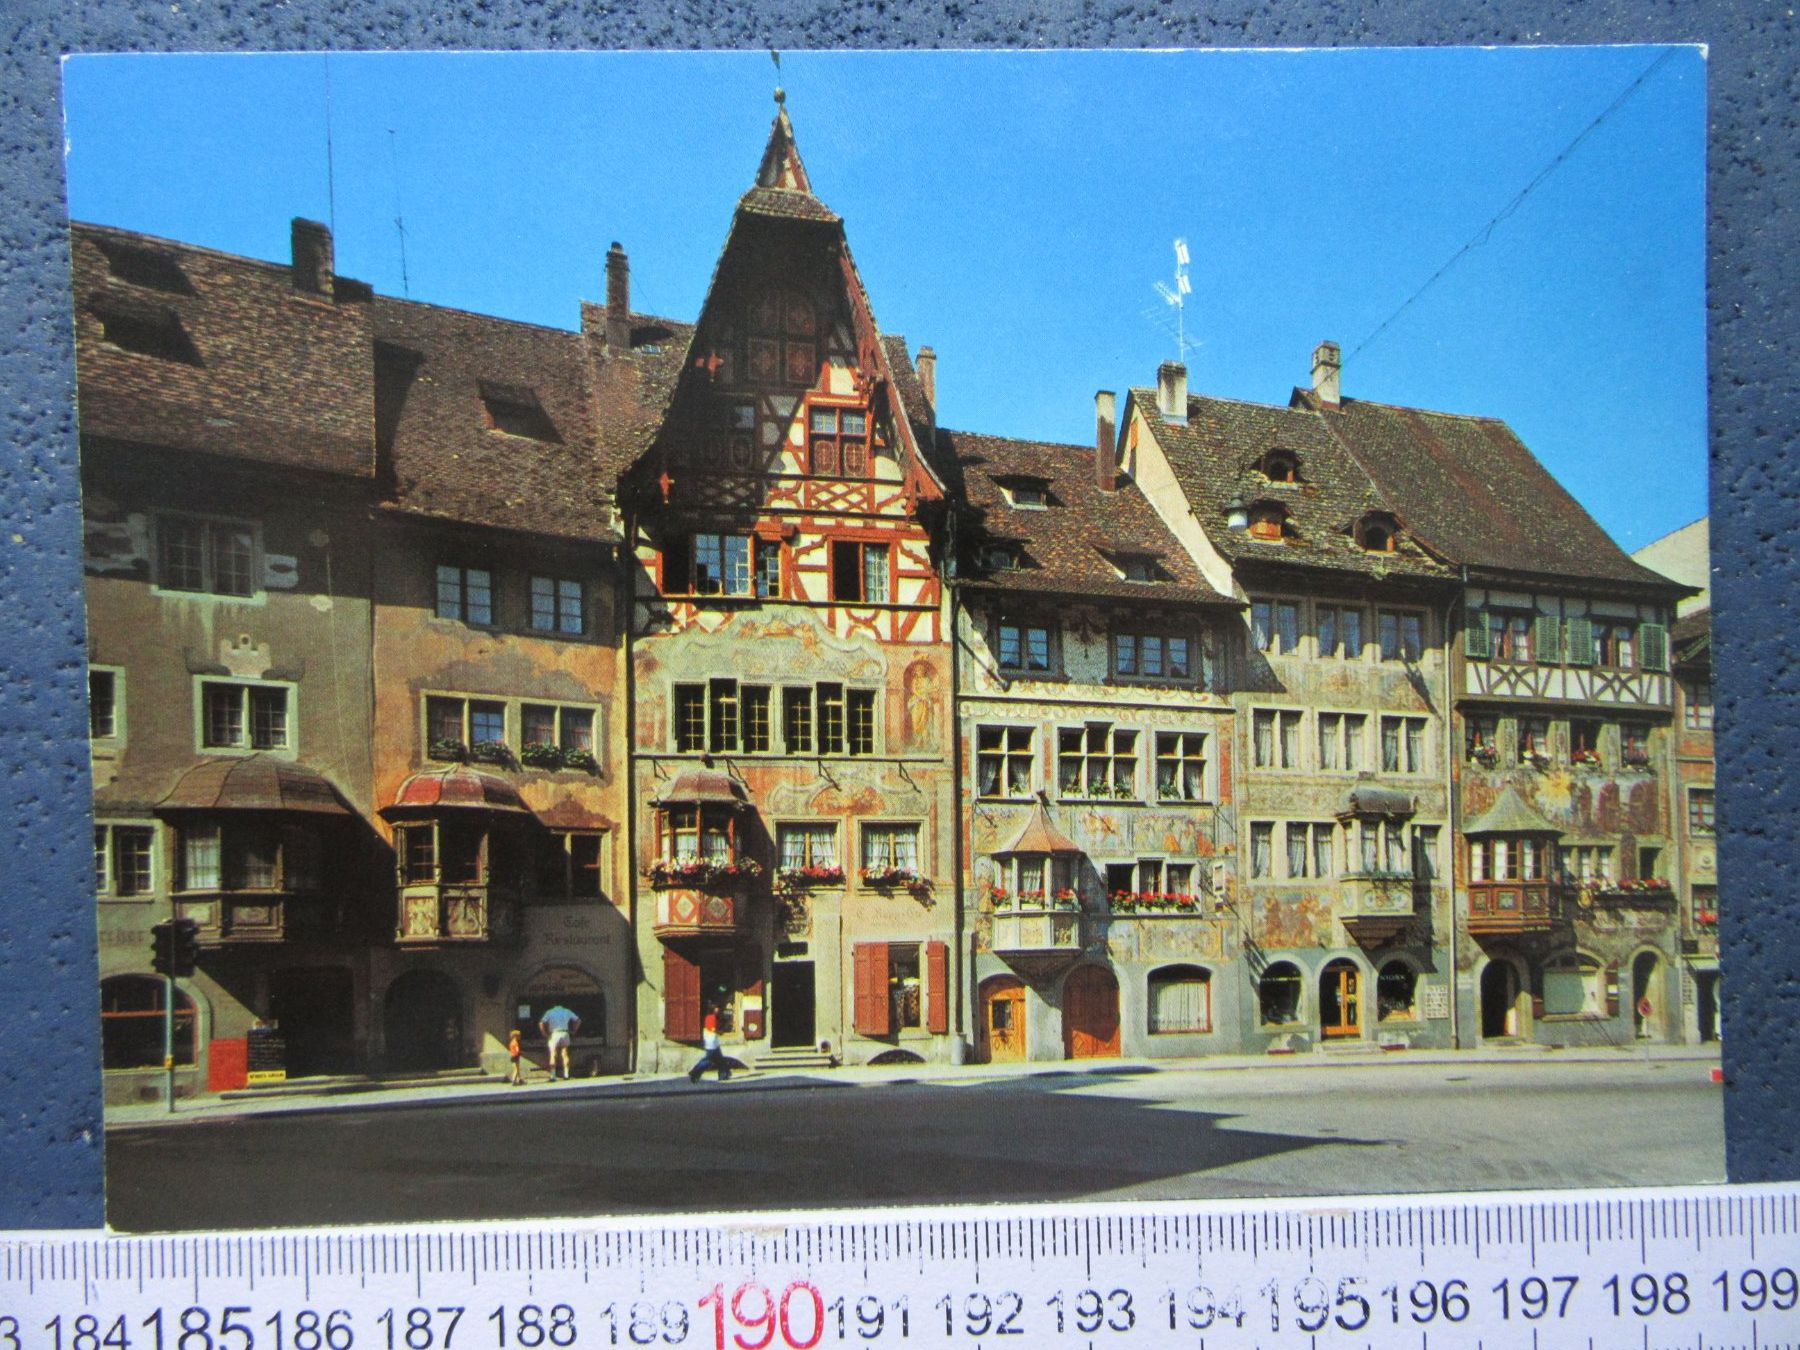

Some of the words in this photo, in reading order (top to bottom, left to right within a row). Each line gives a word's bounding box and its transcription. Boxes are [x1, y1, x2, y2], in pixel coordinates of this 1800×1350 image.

[44, 1313, 132, 1350] 184
[142, 1306, 254, 1350] 185
[265, 1309, 354, 1350] 186
[376, 1307, 466, 1350] 187
[488, 1304, 578, 1348] 188
[600, 1301, 690, 1345] 189
[698, 1279, 825, 1350] 190
[827, 1294, 910, 1339] 191
[935, 1291, 1025, 1336] 192
[1046, 1288, 1136, 1333] 193
[1158, 1281, 1247, 1330] 194
[1258, 1275, 1371, 1332] 195
[1380, 1279, 1471, 1323] 196
[1492, 1276, 1580, 1320] 197
[1603, 1272, 1692, 1317] 198
[1713, 1266, 1800, 1312] 199
